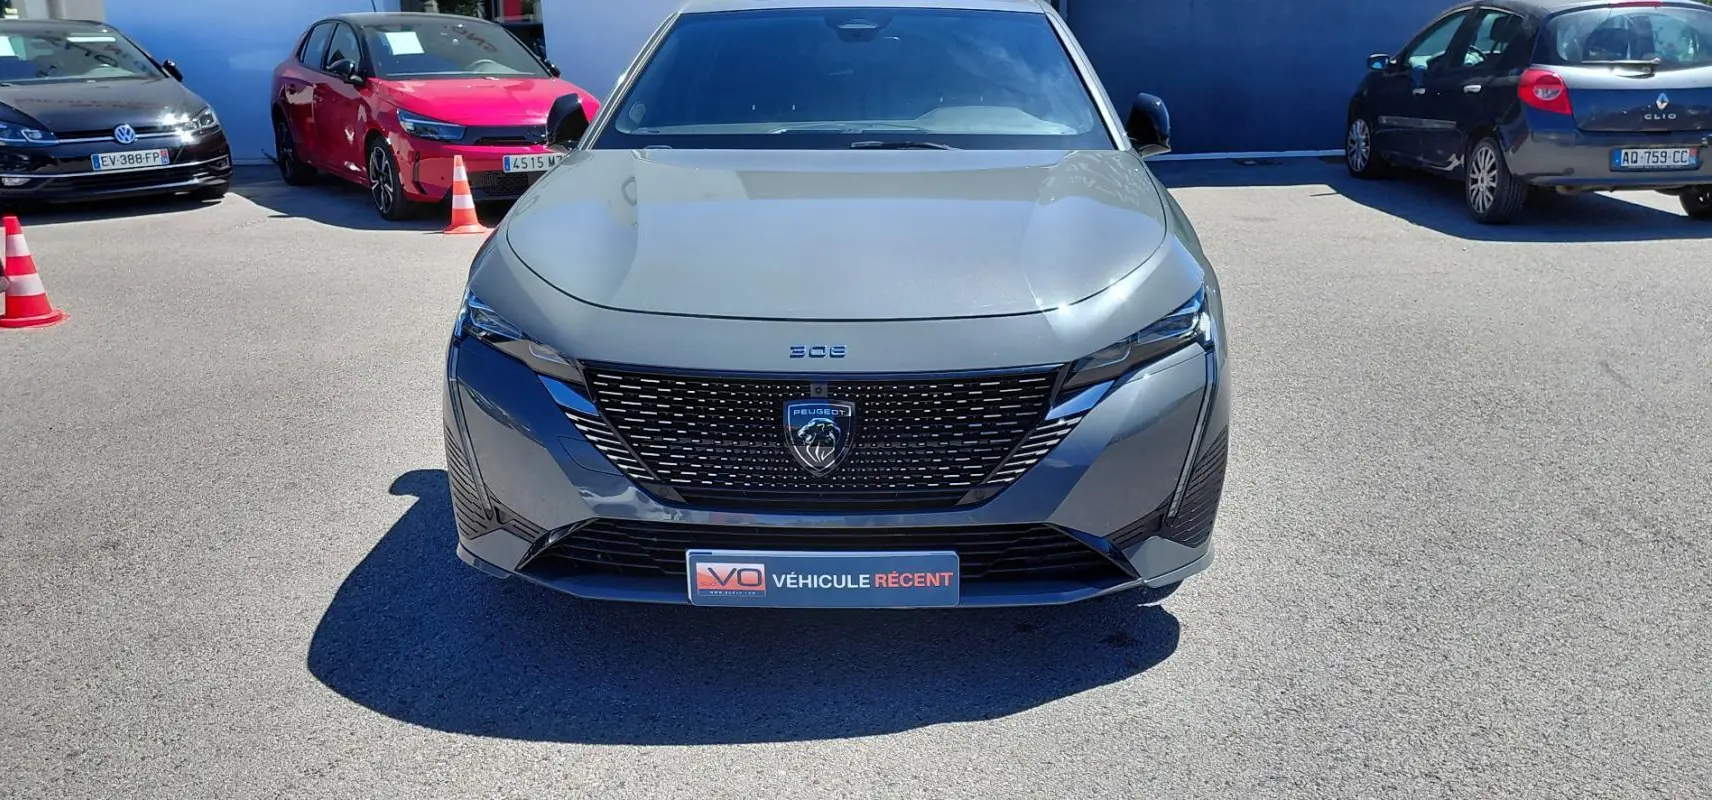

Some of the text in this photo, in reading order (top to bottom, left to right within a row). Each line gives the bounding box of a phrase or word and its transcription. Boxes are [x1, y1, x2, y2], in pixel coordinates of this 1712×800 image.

[100, 152, 160, 167] EV-388-FP
[512, 156, 544, 170] 4515
[789, 345, 847, 359] 308
[793, 407, 847, 417] PEUGEOT
[707, 567, 763, 588] VO
[772, 570, 954, 589] VÉHICULE RÉCENT
